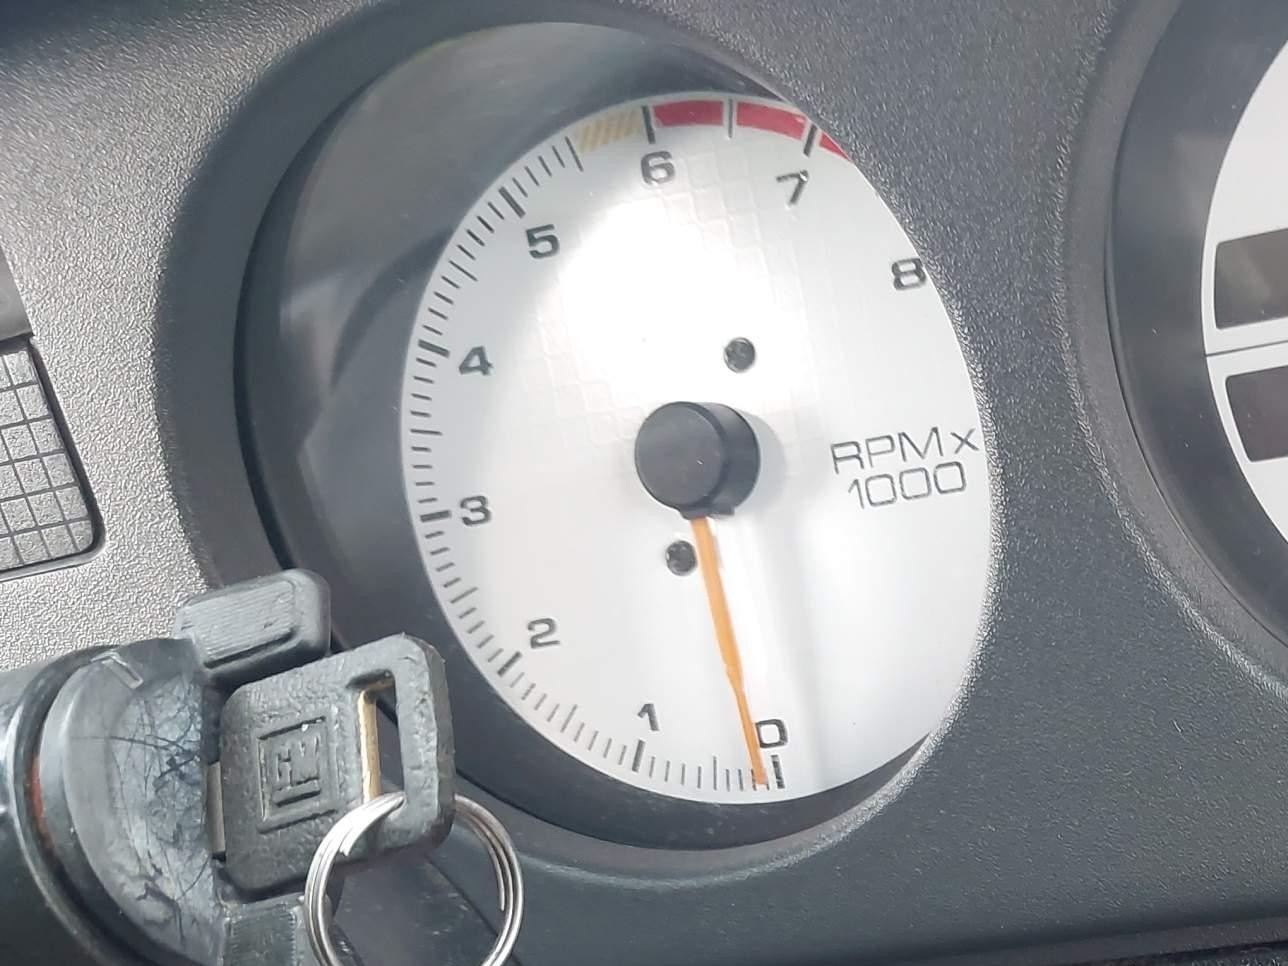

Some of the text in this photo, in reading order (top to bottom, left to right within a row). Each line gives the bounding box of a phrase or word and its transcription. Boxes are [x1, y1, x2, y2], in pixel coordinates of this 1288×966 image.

[641, 150, 675, 186] 6
[776, 170, 810, 206] 7
[527, 226, 560, 260] 5
[892, 257, 928, 292] 8
[459, 345, 494, 377] 4
[830, 426, 944, 475] RPM
[847, 461, 967, 509] 1000
[460, 496, 492, 527] 3
[528, 617, 562, 650] 2
[636, 703, 661, 732] 1
[755, 718, 789, 750] 0
